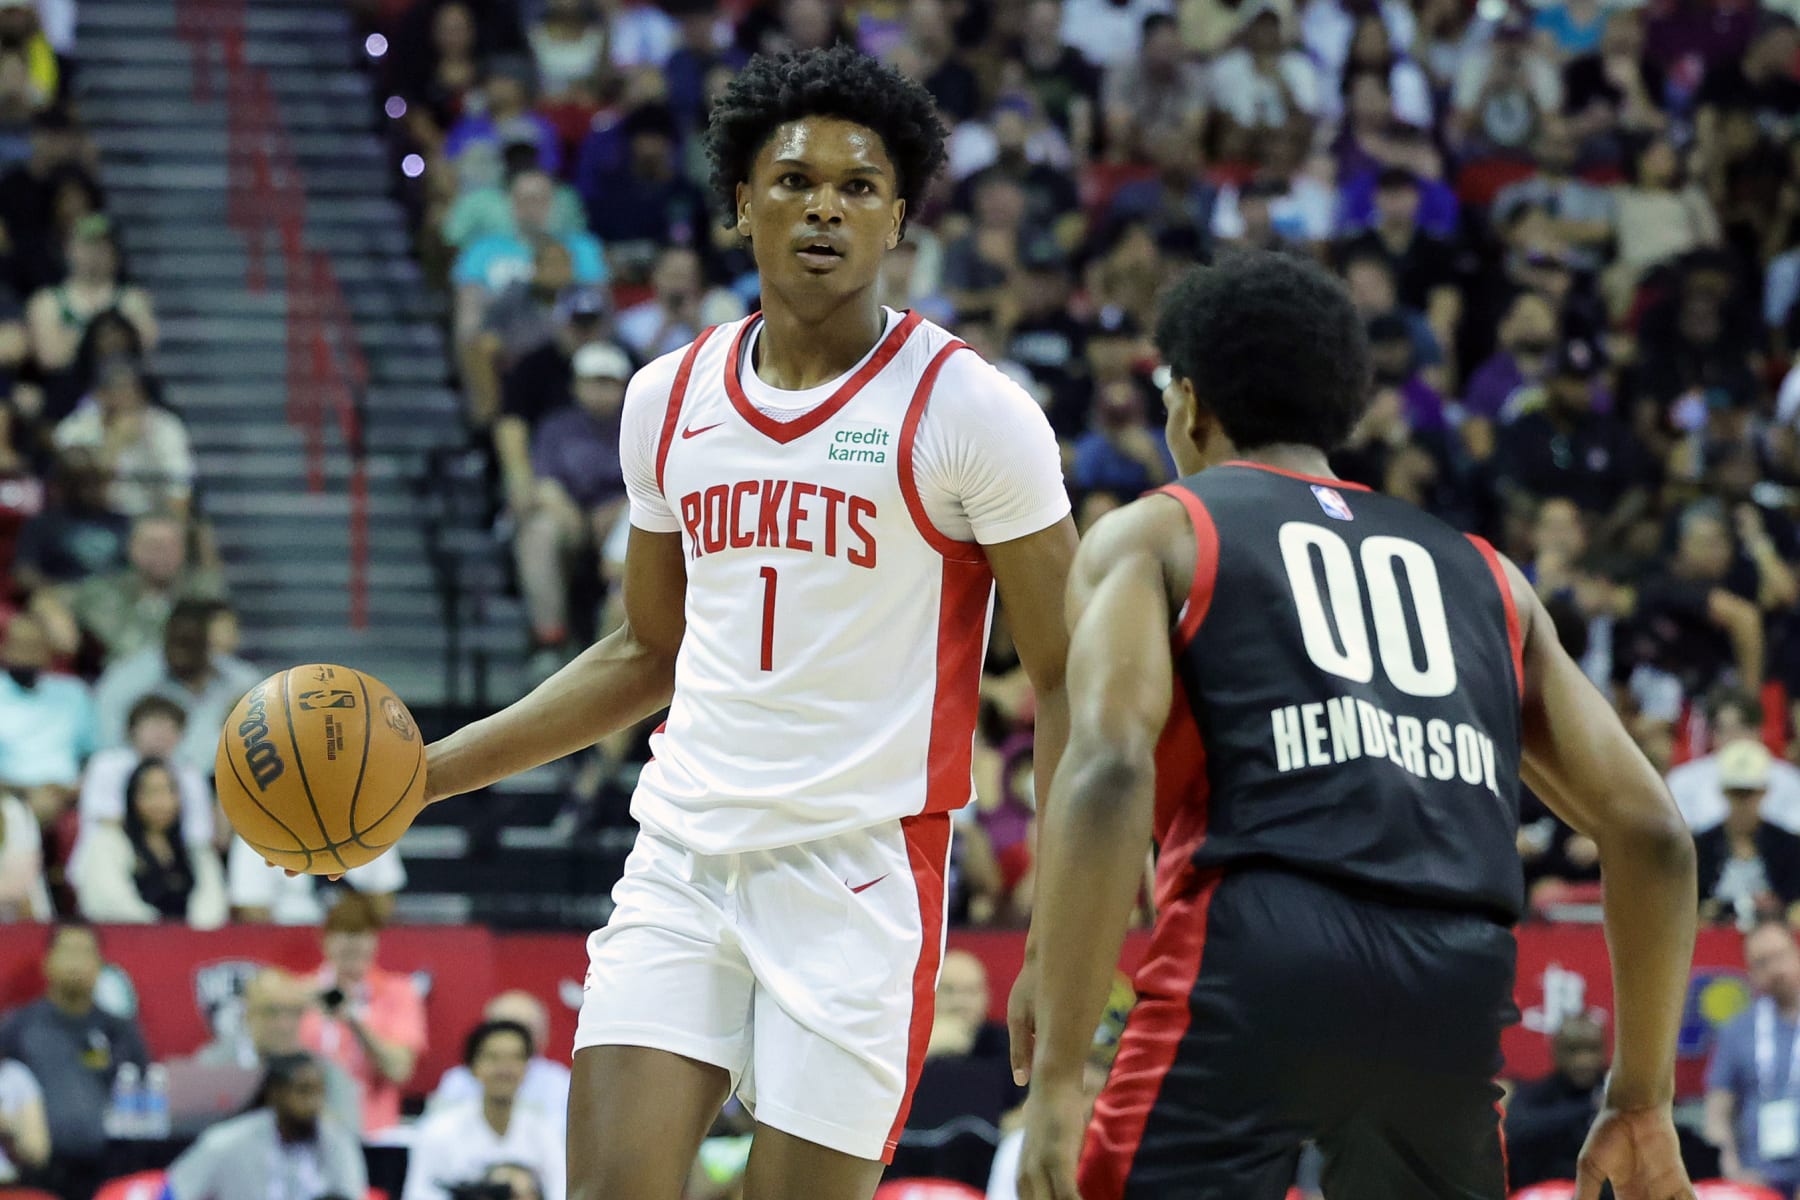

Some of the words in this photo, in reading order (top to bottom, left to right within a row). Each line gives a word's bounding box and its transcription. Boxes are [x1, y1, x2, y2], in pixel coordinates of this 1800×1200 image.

[828, 444, 886, 464] karma
[835, 428, 890, 446] credit
[680, 479, 877, 570] ROCKETS
[759, 566, 778, 672] 1
[1278, 521, 1457, 698] 00
[238, 687, 284, 793] Wilso
